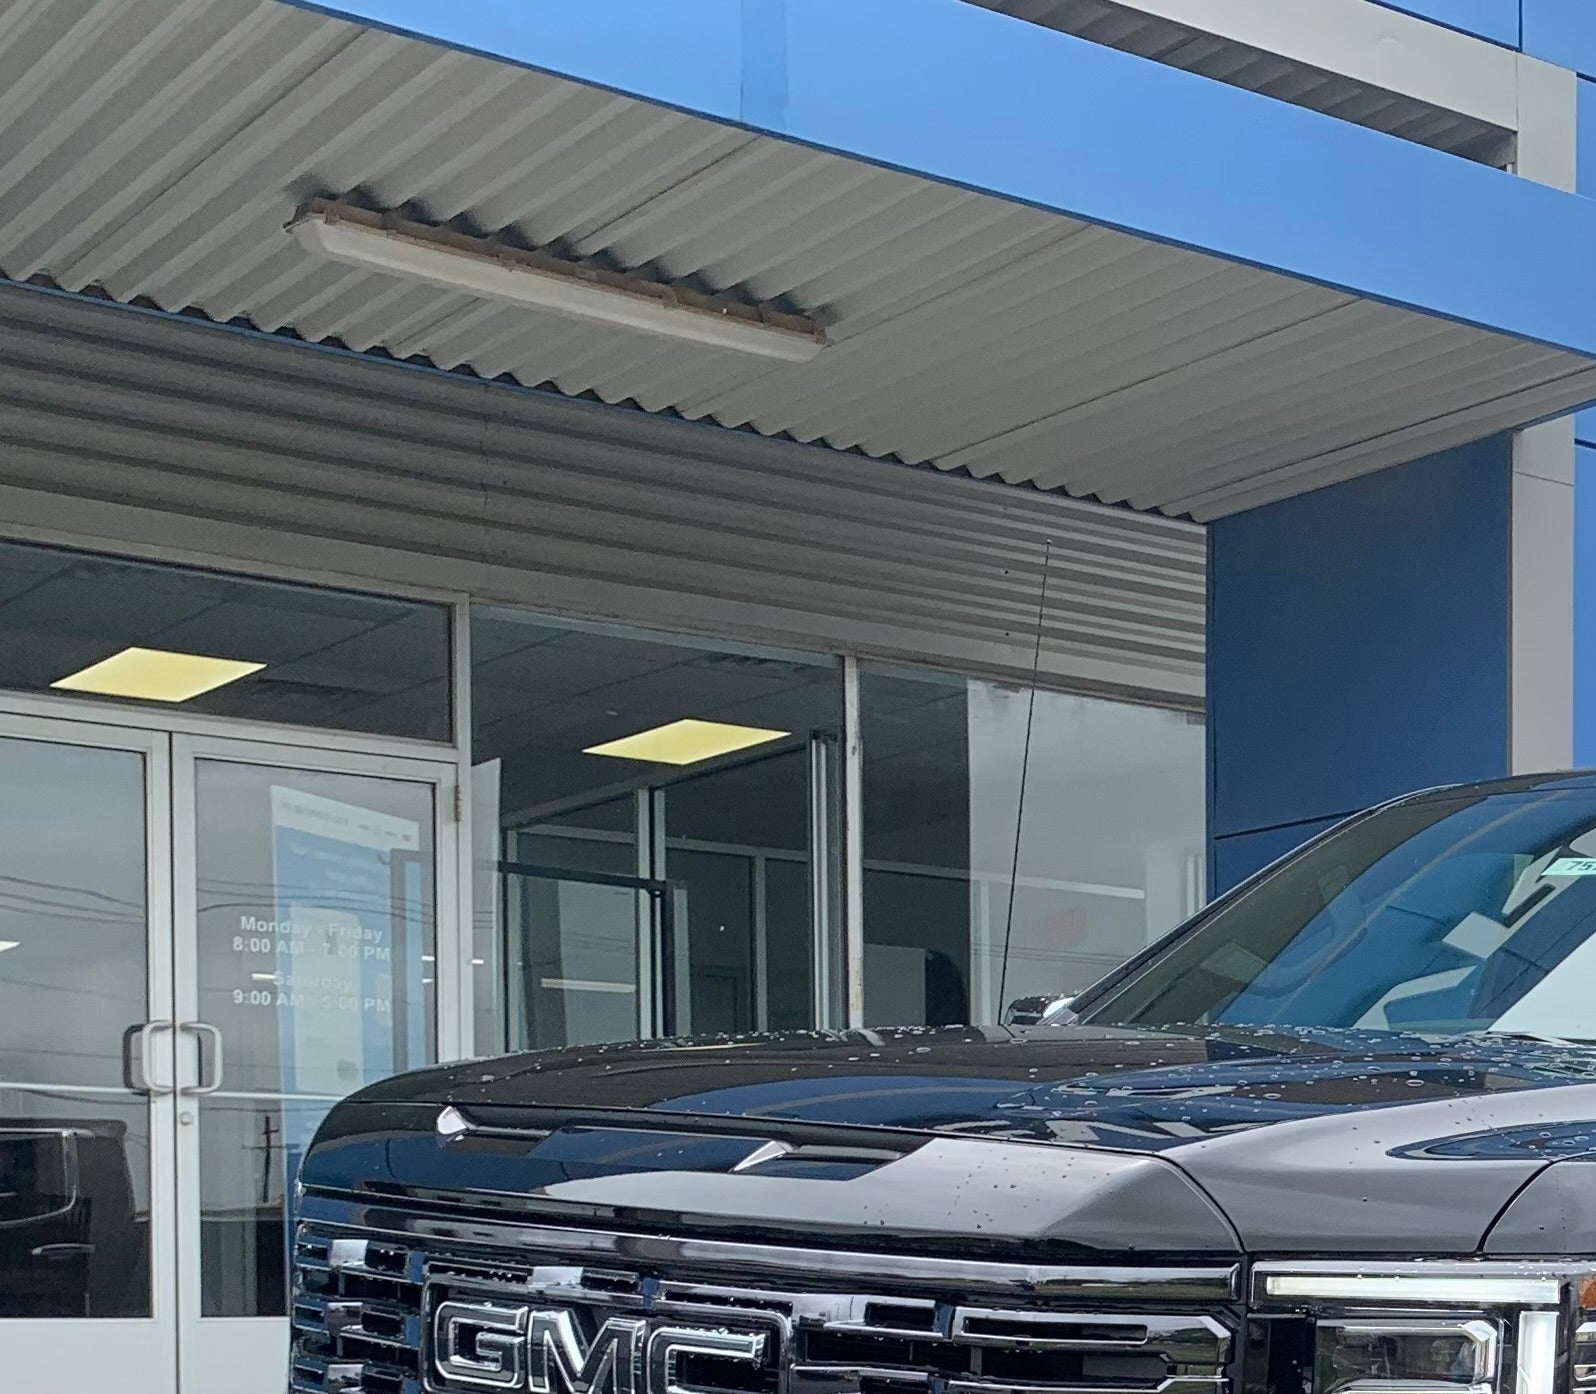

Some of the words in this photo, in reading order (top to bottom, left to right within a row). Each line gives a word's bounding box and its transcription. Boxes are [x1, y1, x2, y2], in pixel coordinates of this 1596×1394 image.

[240, 916, 311, 938] Monday
[328, 923, 383, 943] Friday
[232, 936, 271, 953] 8:00
[276, 940, 304, 955] AM
[363, 946, 391, 961] PM
[273, 970, 353, 992] Saturday
[232, 989, 271, 1006] 9:00
[276, 993, 304, 1007] AM
[363, 997, 391, 1013] PM
